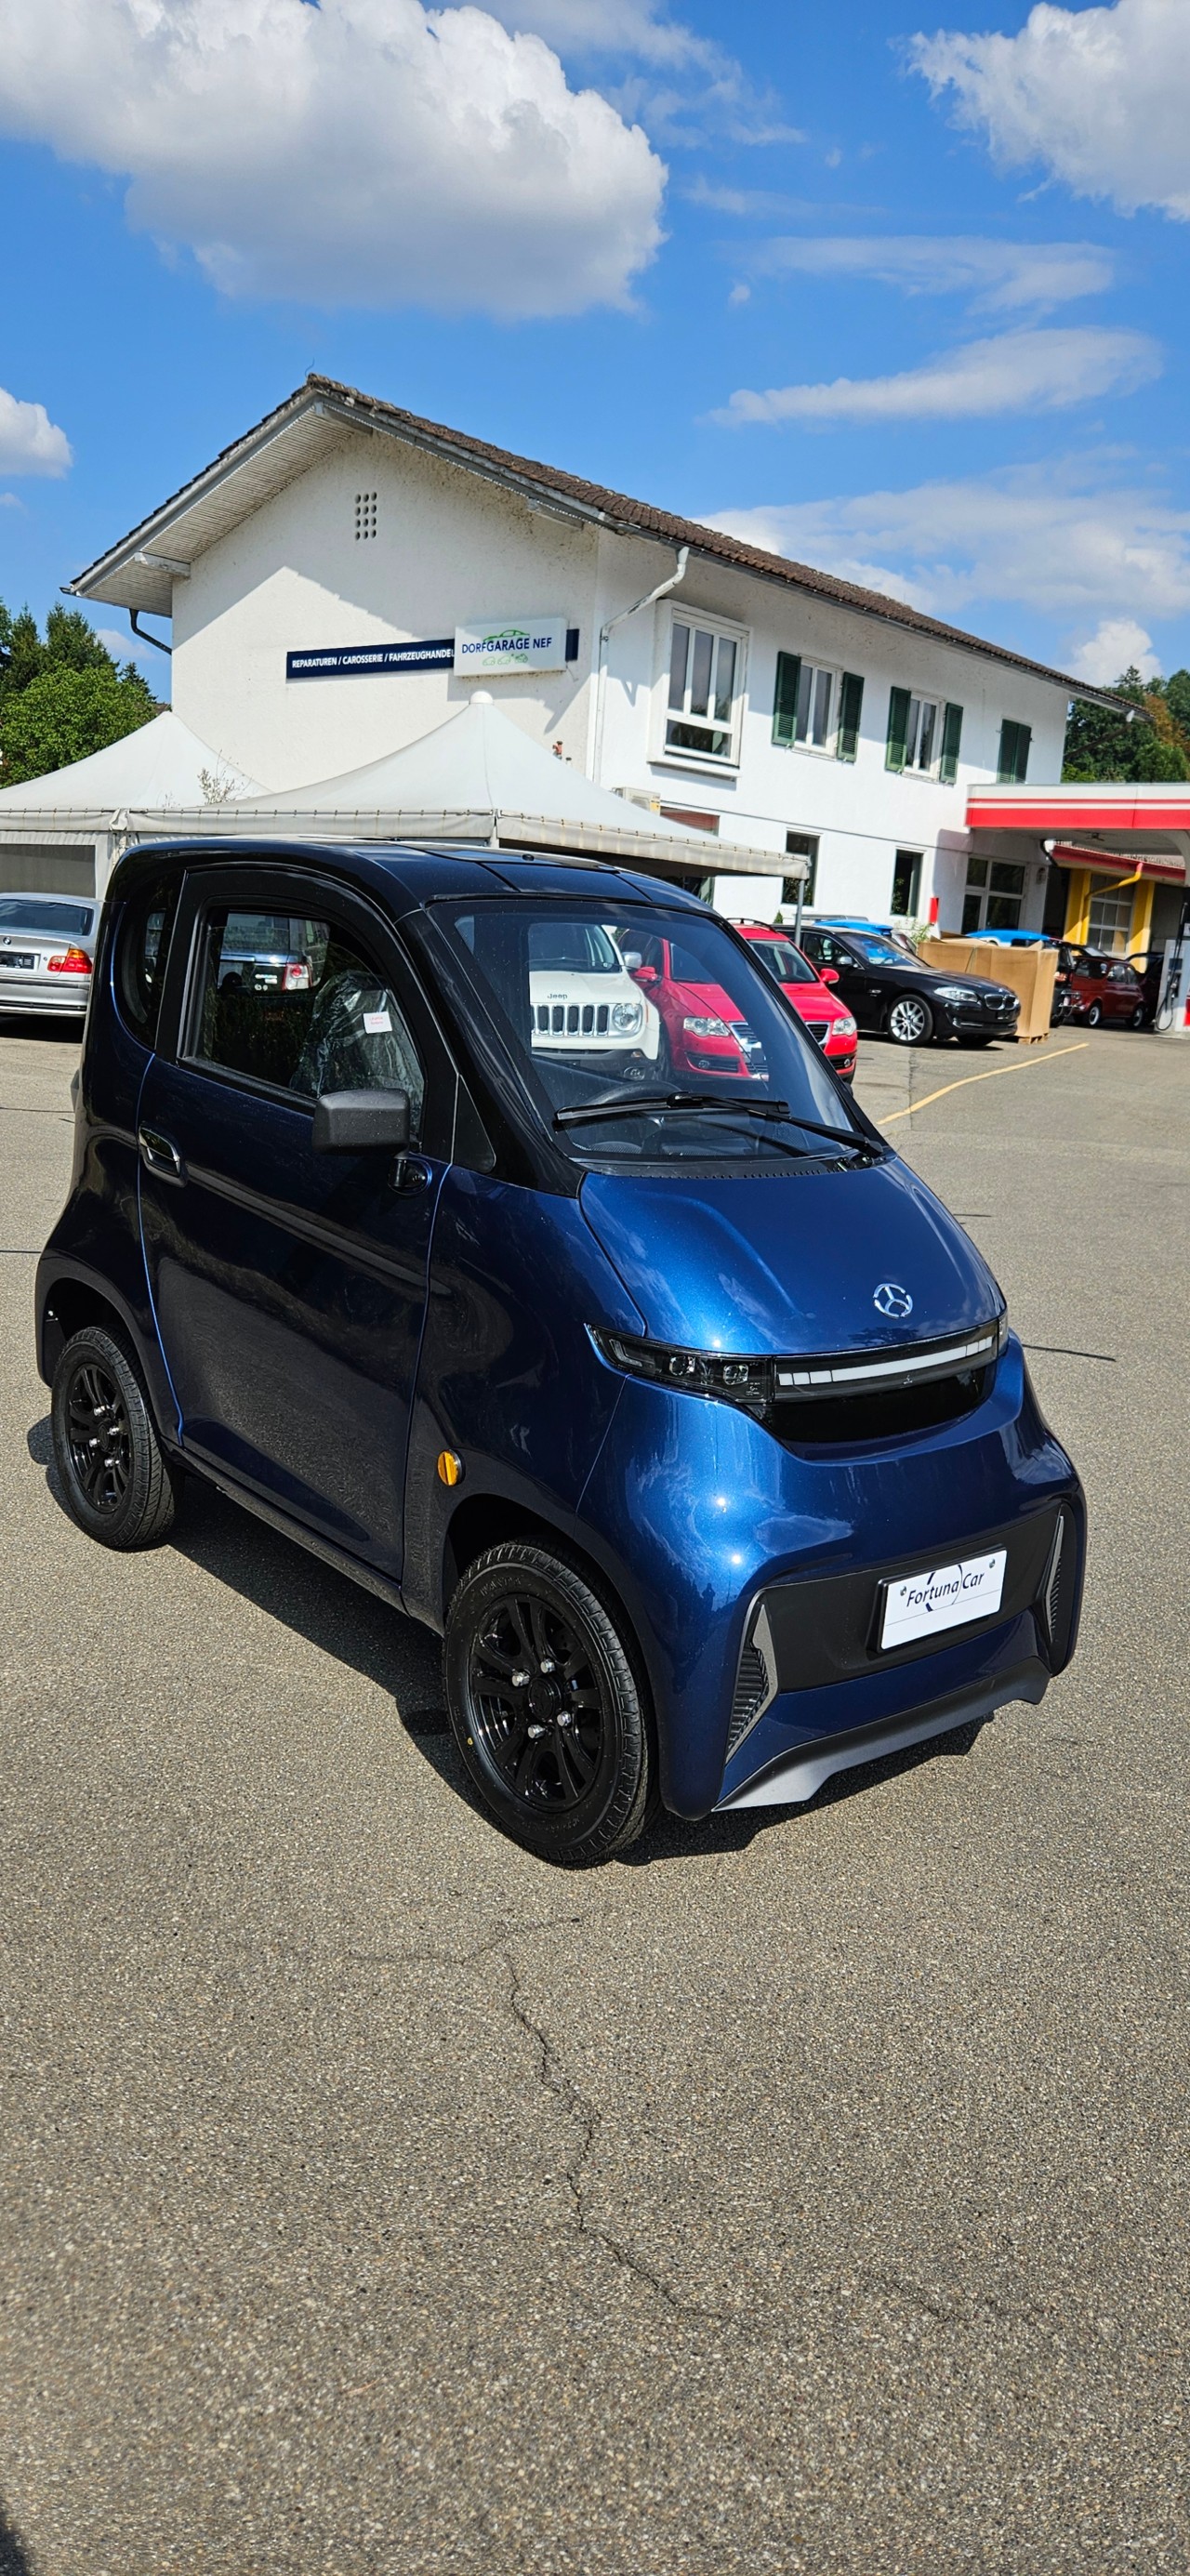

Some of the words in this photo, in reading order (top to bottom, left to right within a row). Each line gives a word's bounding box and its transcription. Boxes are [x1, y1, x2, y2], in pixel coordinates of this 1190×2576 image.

[461, 638, 530, 654] DORFGARAGE
[533, 637, 553, 649] NEF
[292, 656, 337, 668] REPARATUREN
[342, 654, 383, 665] CAROSSERIE
[906, 1579, 960, 1607] Fortuna
[962, 1572, 985, 1590] Car
